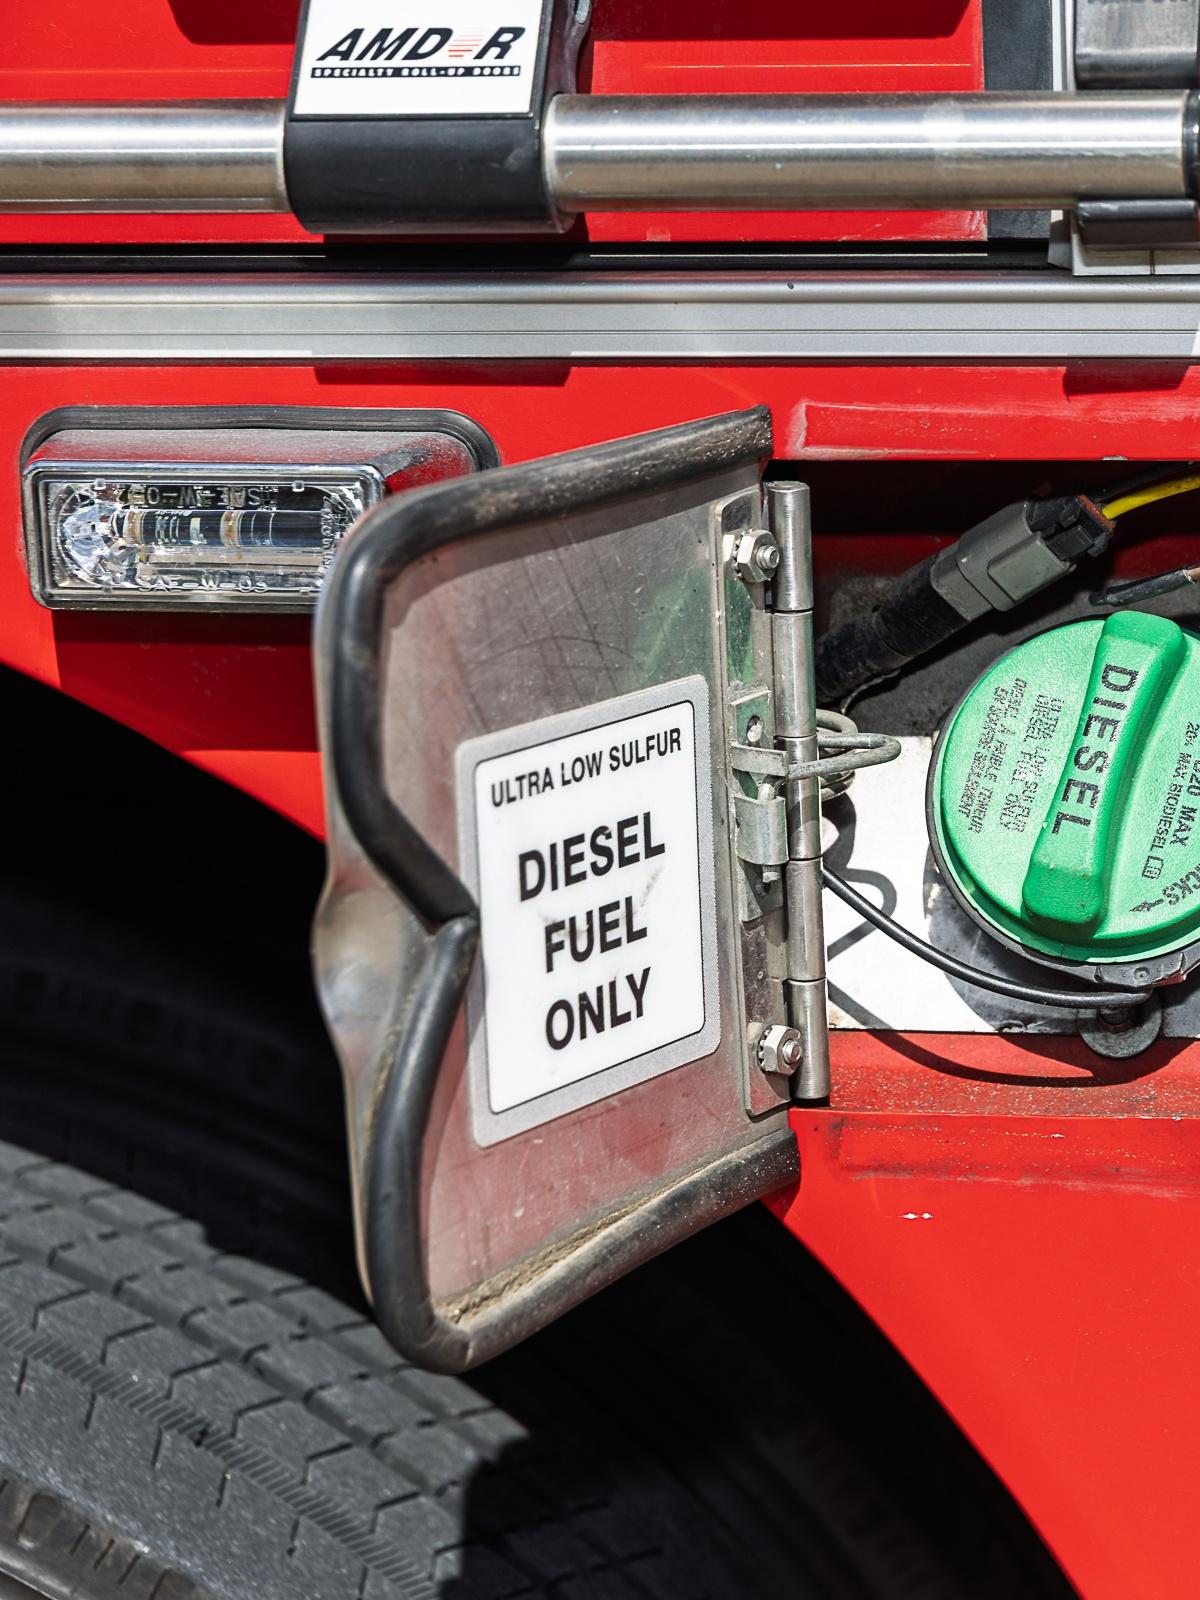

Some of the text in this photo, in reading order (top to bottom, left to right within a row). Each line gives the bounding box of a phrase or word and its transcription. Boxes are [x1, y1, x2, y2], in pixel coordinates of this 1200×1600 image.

[314, 66, 520, 77] SPECIALTY ROLL-UP DOORS
[1038, 698, 1064, 739] ULTRA
[1051, 663, 1139, 836] DIESEL
[491, 727, 682, 808] ULTRA LOW SULFUR
[999, 694, 1050, 830] DIESEL FUEL ONLY
[1173, 752, 1192, 780] MAX
[518, 811, 666, 902] DIESEL
[1151, 783, 1183, 851] BIODIESEL
[1170, 805, 1198, 847] MAX
[544, 895, 648, 974] FUEL
[544, 966, 652, 1051] ONLY
